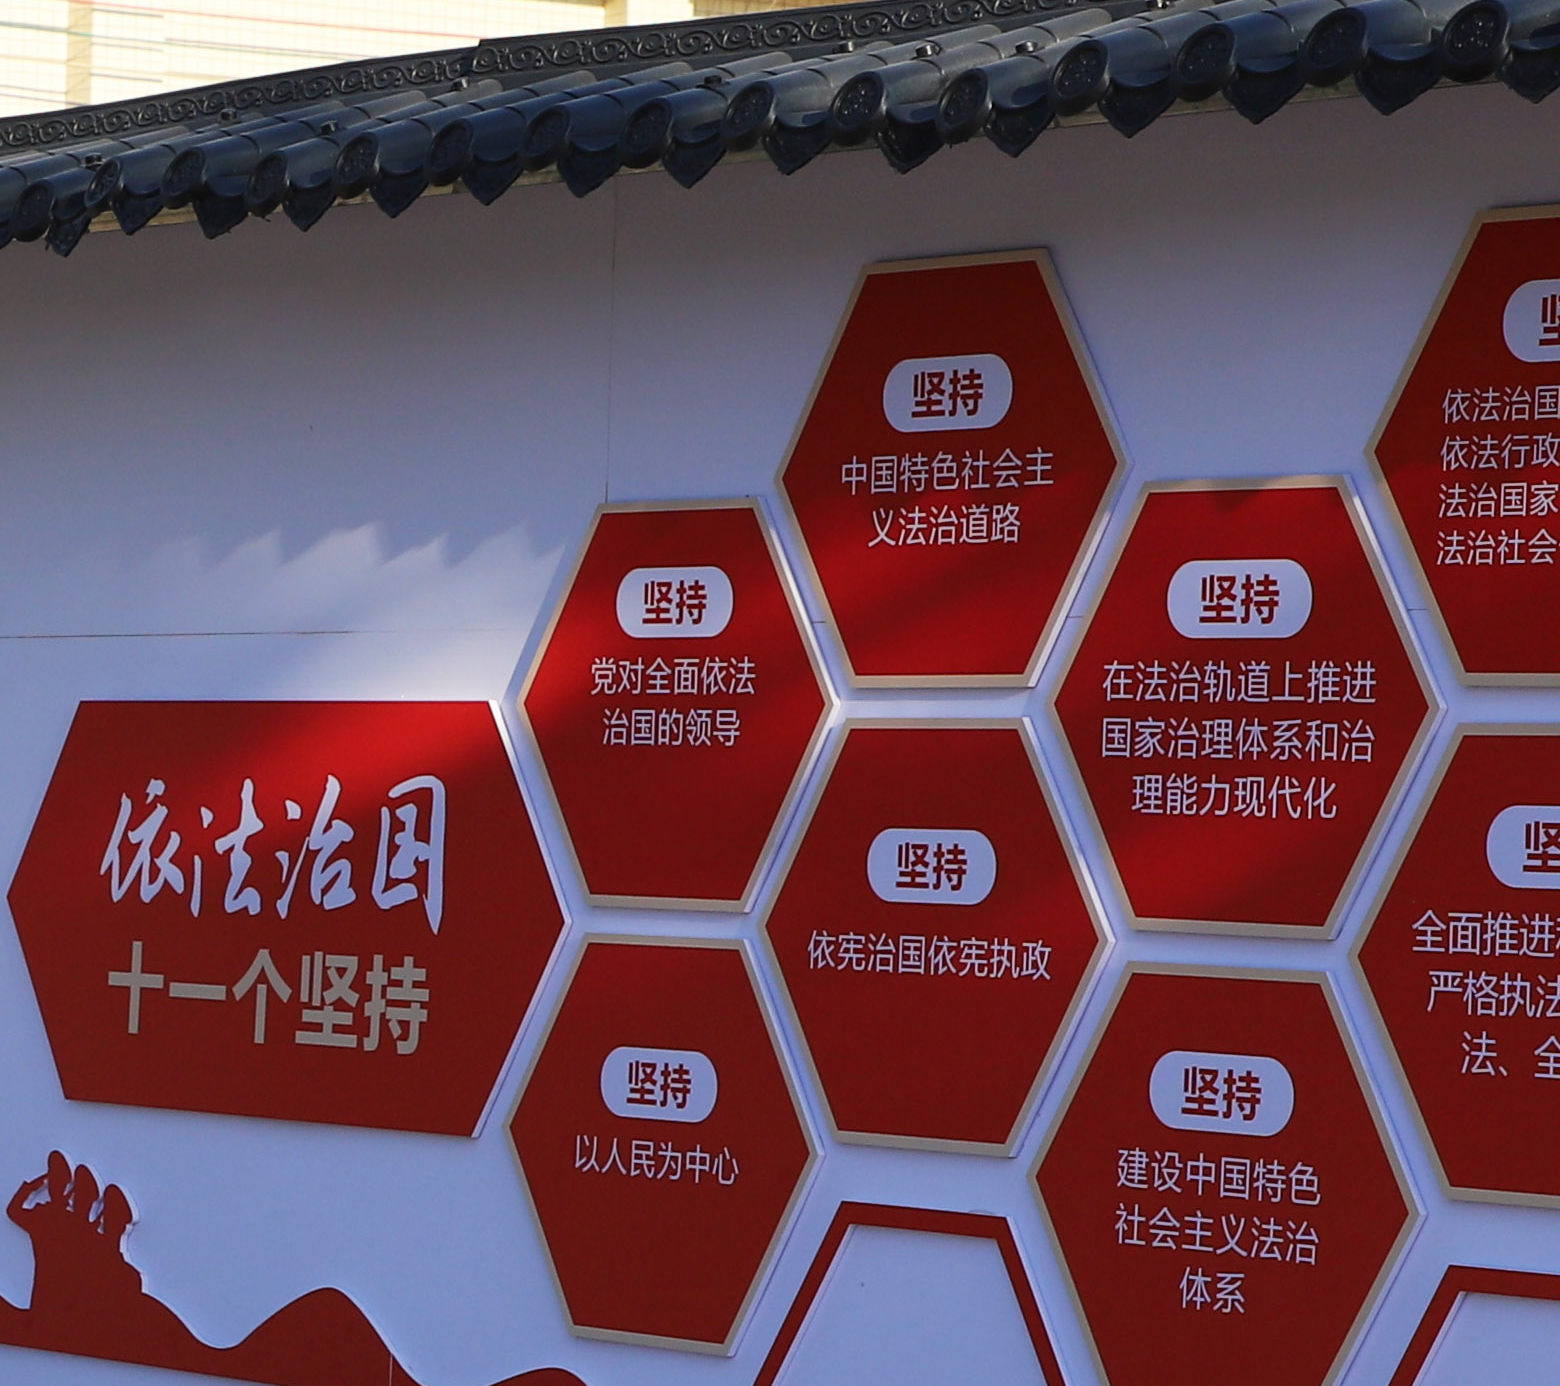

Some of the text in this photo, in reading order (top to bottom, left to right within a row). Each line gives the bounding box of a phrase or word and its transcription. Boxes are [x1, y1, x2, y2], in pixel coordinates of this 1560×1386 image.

[910, 368, 984, 418] 坚持
[840, 446, 1054, 496] 中国特色社会主
[867, 501, 1021, 549] 义法治道路
[641, 578, 708, 626] 坚持
[1198, 573, 1280, 625] 坚持
[590, 655, 756, 696] 党对全面依法
[1101, 660, 1377, 705] 在法治轨道上推进
[601, 707, 740, 747] 治国的领导
[1101, 716, 1376, 763] 国家治理体系和治
[1130, 773, 1337, 820] 理能力现代化
[99, 774, 447, 935] 依法治国
[894, 841, 968, 891] 坚持
[807, 930, 1053, 981] 依宪治国依宪执政
[107, 940, 430, 1055] 十一个坚持
[625, 1060, 692, 1110] 坚持
[1180, 1065, 1262, 1122] 坚持
[573, 1134, 740, 1185] 以人民为中心
[1116, 1146, 1322, 1207] 建设中国特色
[1114, 1202, 1320, 1266] 社会主义法治
[1178, 1266, 1246, 1315] 体系
